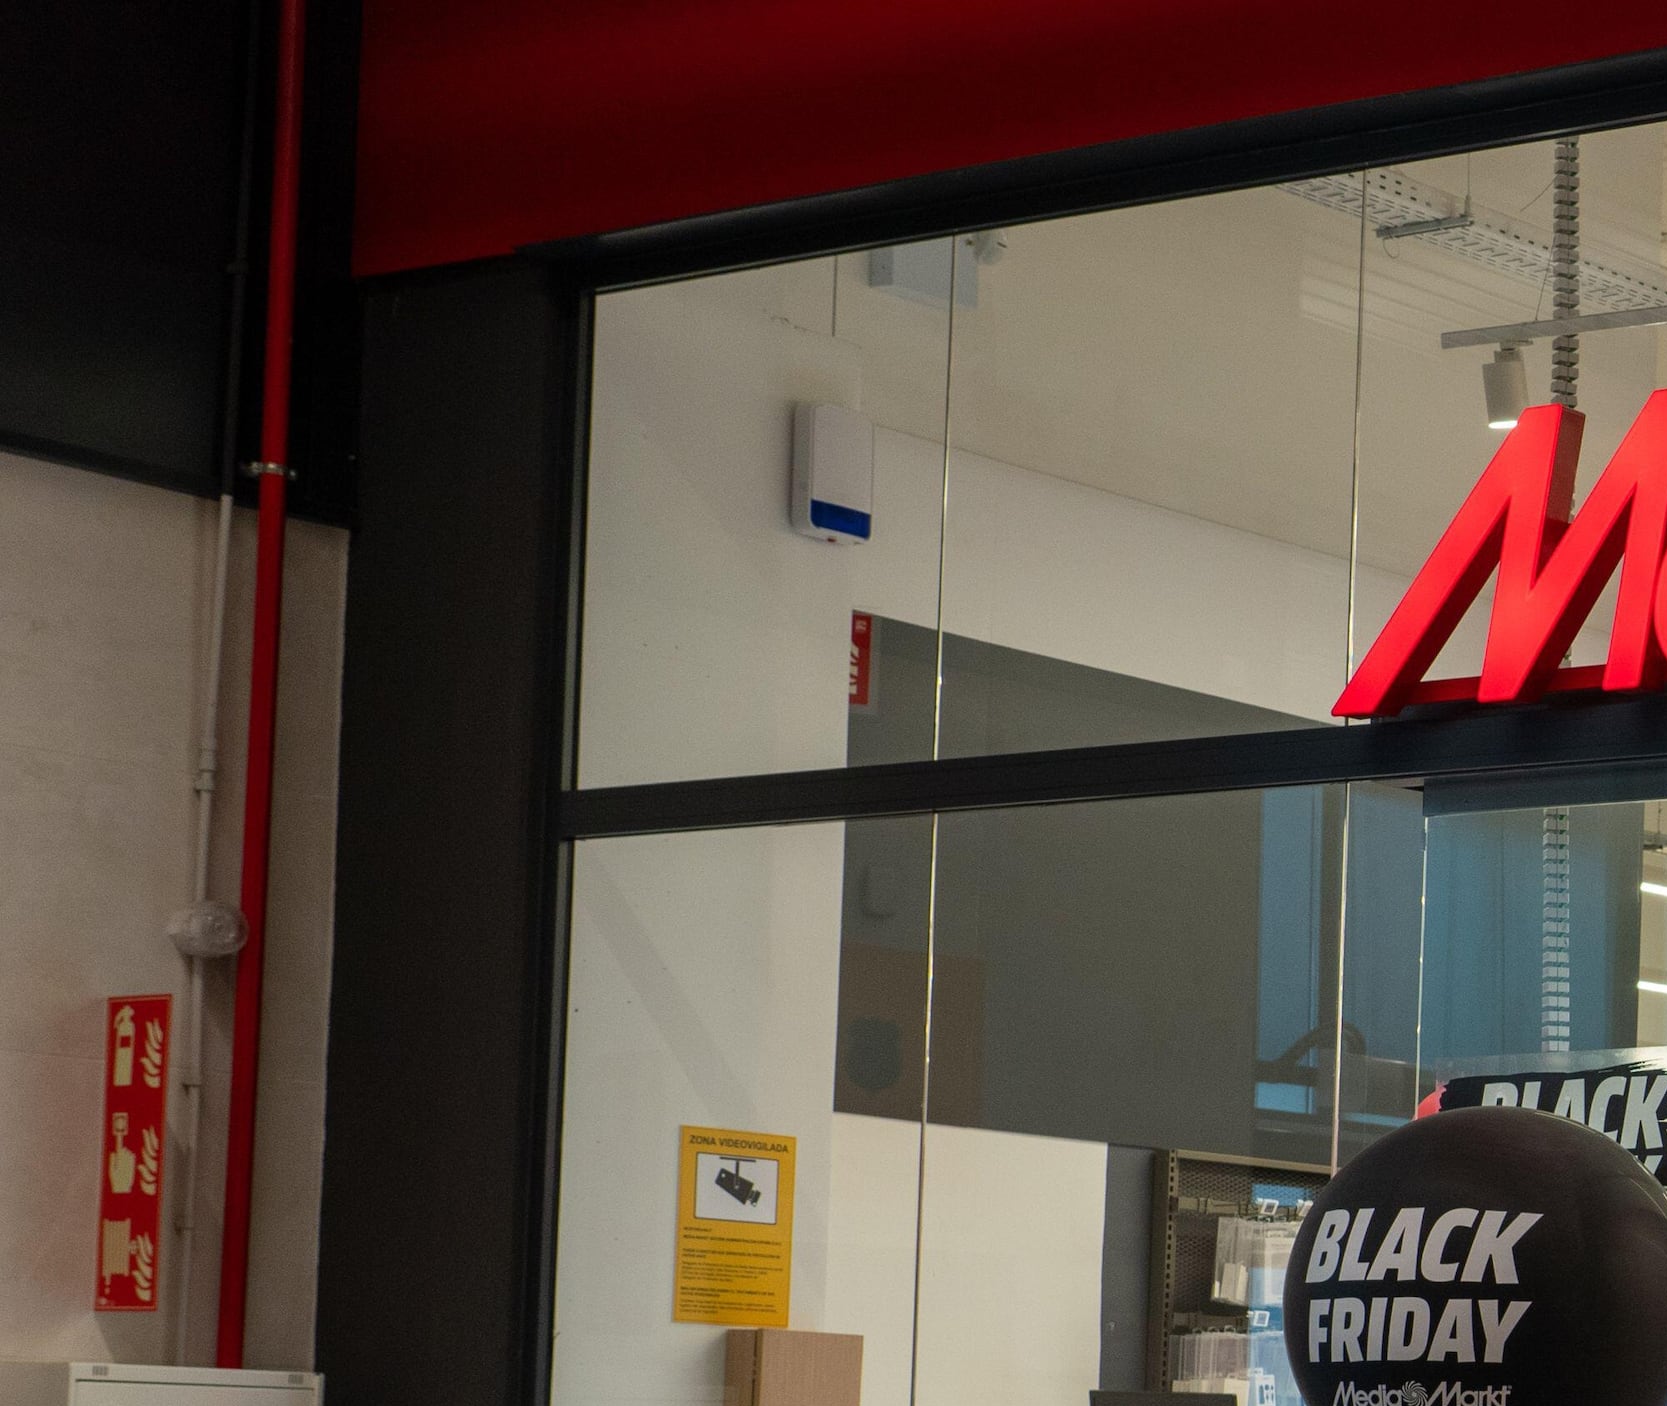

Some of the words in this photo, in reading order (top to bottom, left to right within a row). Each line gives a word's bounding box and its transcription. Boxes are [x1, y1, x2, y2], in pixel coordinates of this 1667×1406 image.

[690, 1134, 716, 1146] ZONA
[719, 1138, 789, 1153] VIDEOVIGILADA
[1305, 1207, 1544, 1284] BLACK
[1308, 1297, 1533, 1363] FRIDAY
